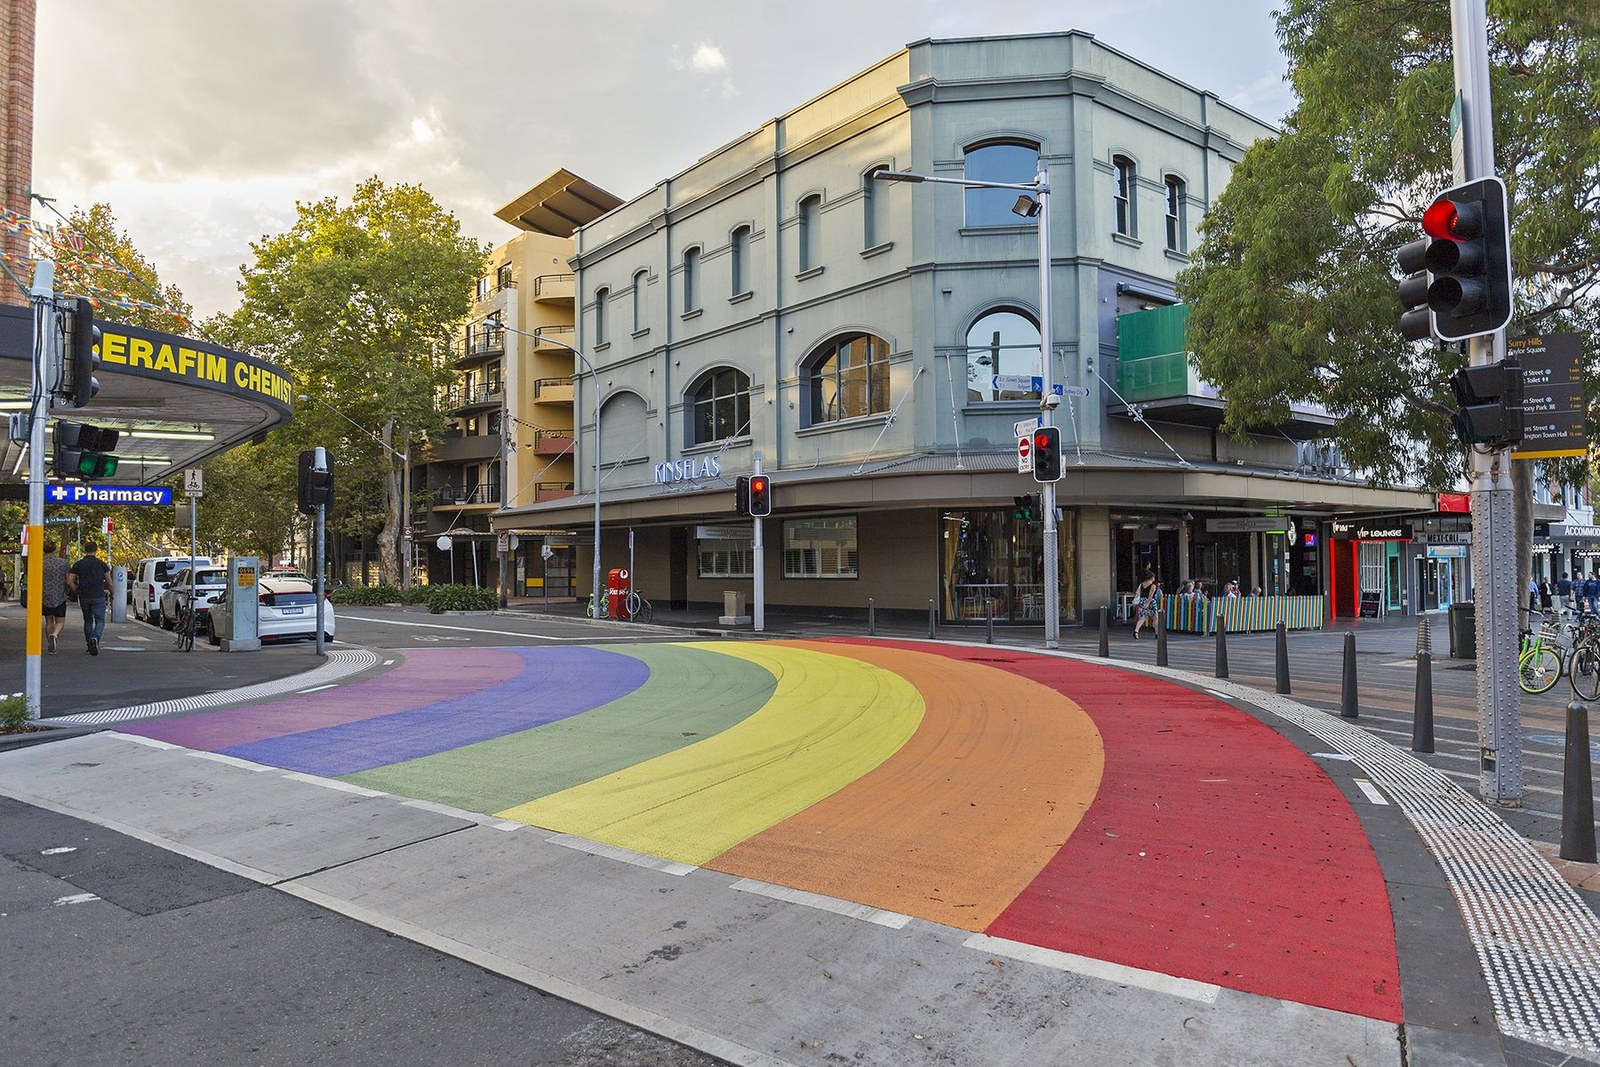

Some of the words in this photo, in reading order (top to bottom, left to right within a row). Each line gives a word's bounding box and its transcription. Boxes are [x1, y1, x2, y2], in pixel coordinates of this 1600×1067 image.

[1508, 339, 1526, 348] Surry
[1528, 337, 1542, 346] Hills
[92, 332, 227, 383] ERAFIM
[234, 361, 292, 405] CHEMIST
[655, 455, 719, 483] KINSELAS
[74, 486, 163, 504] Pharmacy
[1370, 529, 1401, 537] LOUNGE
